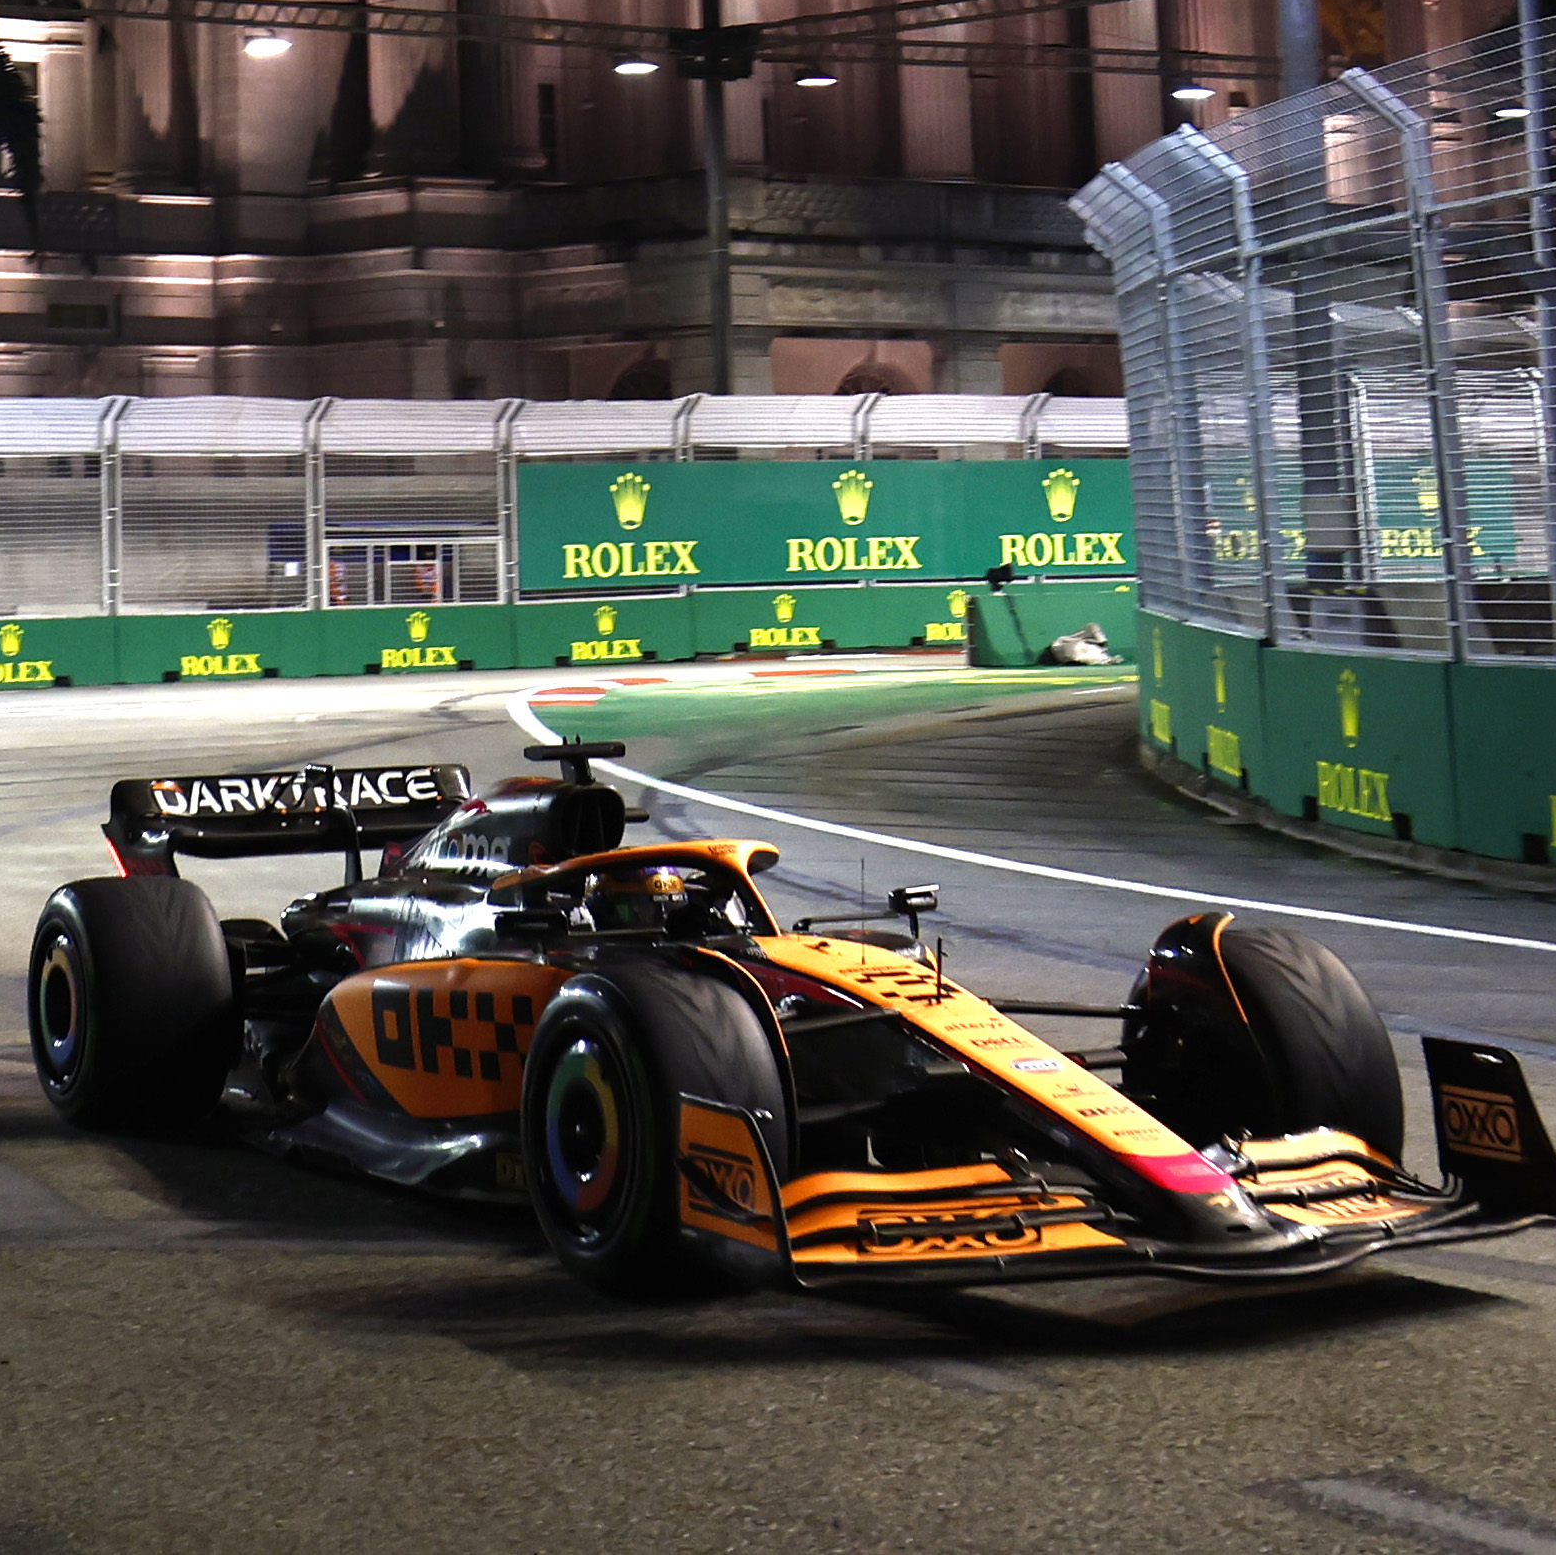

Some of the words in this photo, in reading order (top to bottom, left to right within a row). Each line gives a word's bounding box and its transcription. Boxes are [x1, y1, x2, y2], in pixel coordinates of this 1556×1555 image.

[787, 536, 922, 571] ROLEX
[1001, 533, 1126, 567] ROLEX
[1380, 526, 1486, 558] ROLX
[563, 541, 700, 579] ROLEX
[749, 627, 821, 647] ROLEX
[925, 623, 966, 641] ROL
[180, 654, 261, 677] ROLEX
[381, 646, 458, 669] ROLEX
[571, 639, 643, 661] ROLEX
[151, 770, 437, 814] DARKTRACE
[1317, 760, 1393, 822] ROLEX
[372, 980, 534, 1081] OKX
[1446, 1099, 1515, 1146] OXXO
